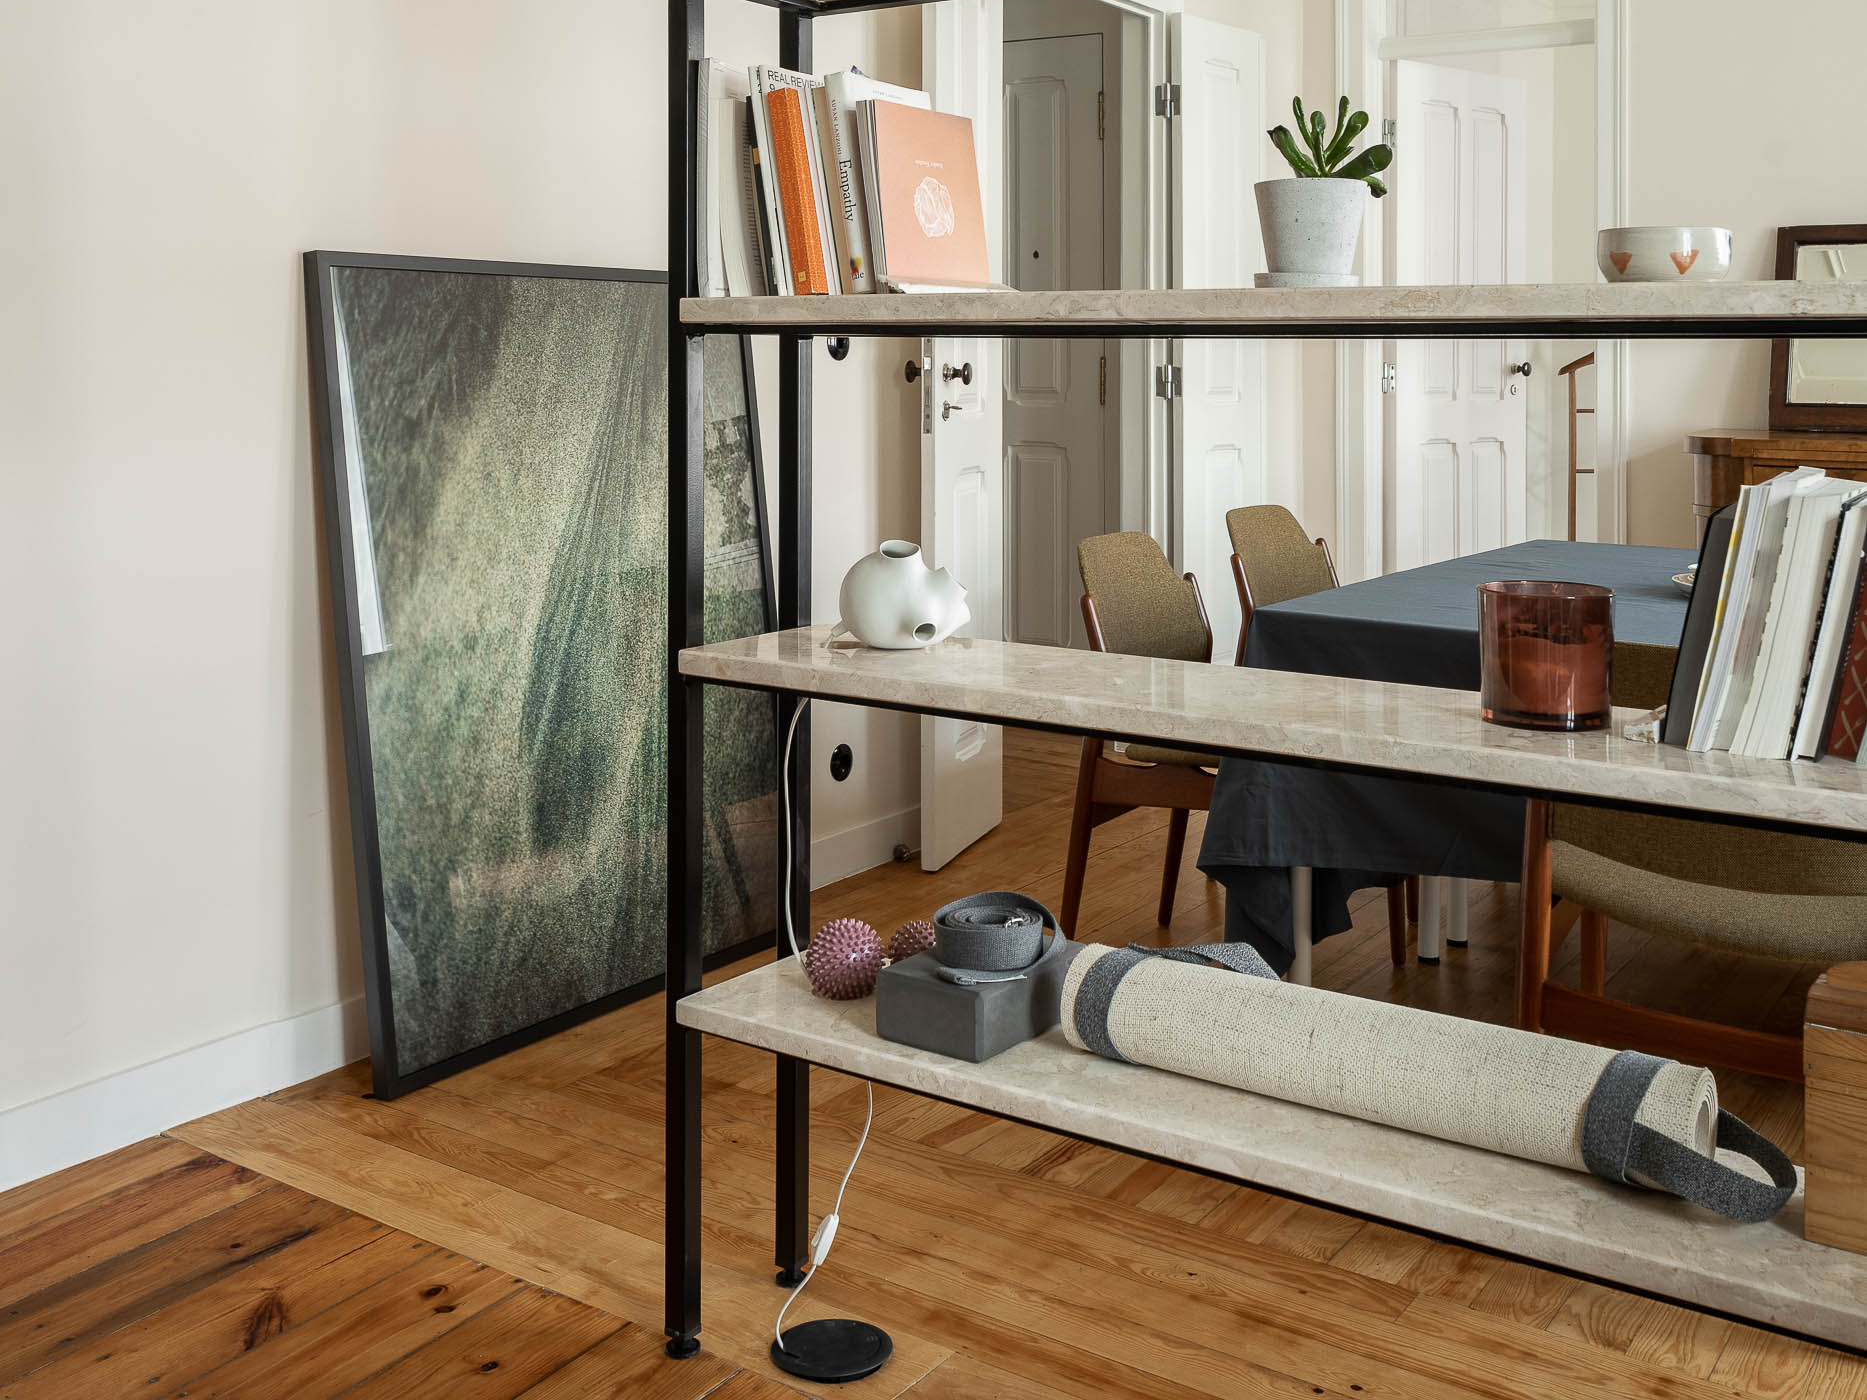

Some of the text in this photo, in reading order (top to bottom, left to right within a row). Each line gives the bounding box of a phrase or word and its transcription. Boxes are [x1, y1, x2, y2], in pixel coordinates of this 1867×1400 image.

[767, 70, 790, 85] REAL
[834, 123, 842, 156] LANZONI
[839, 160, 857, 222] Empathy
